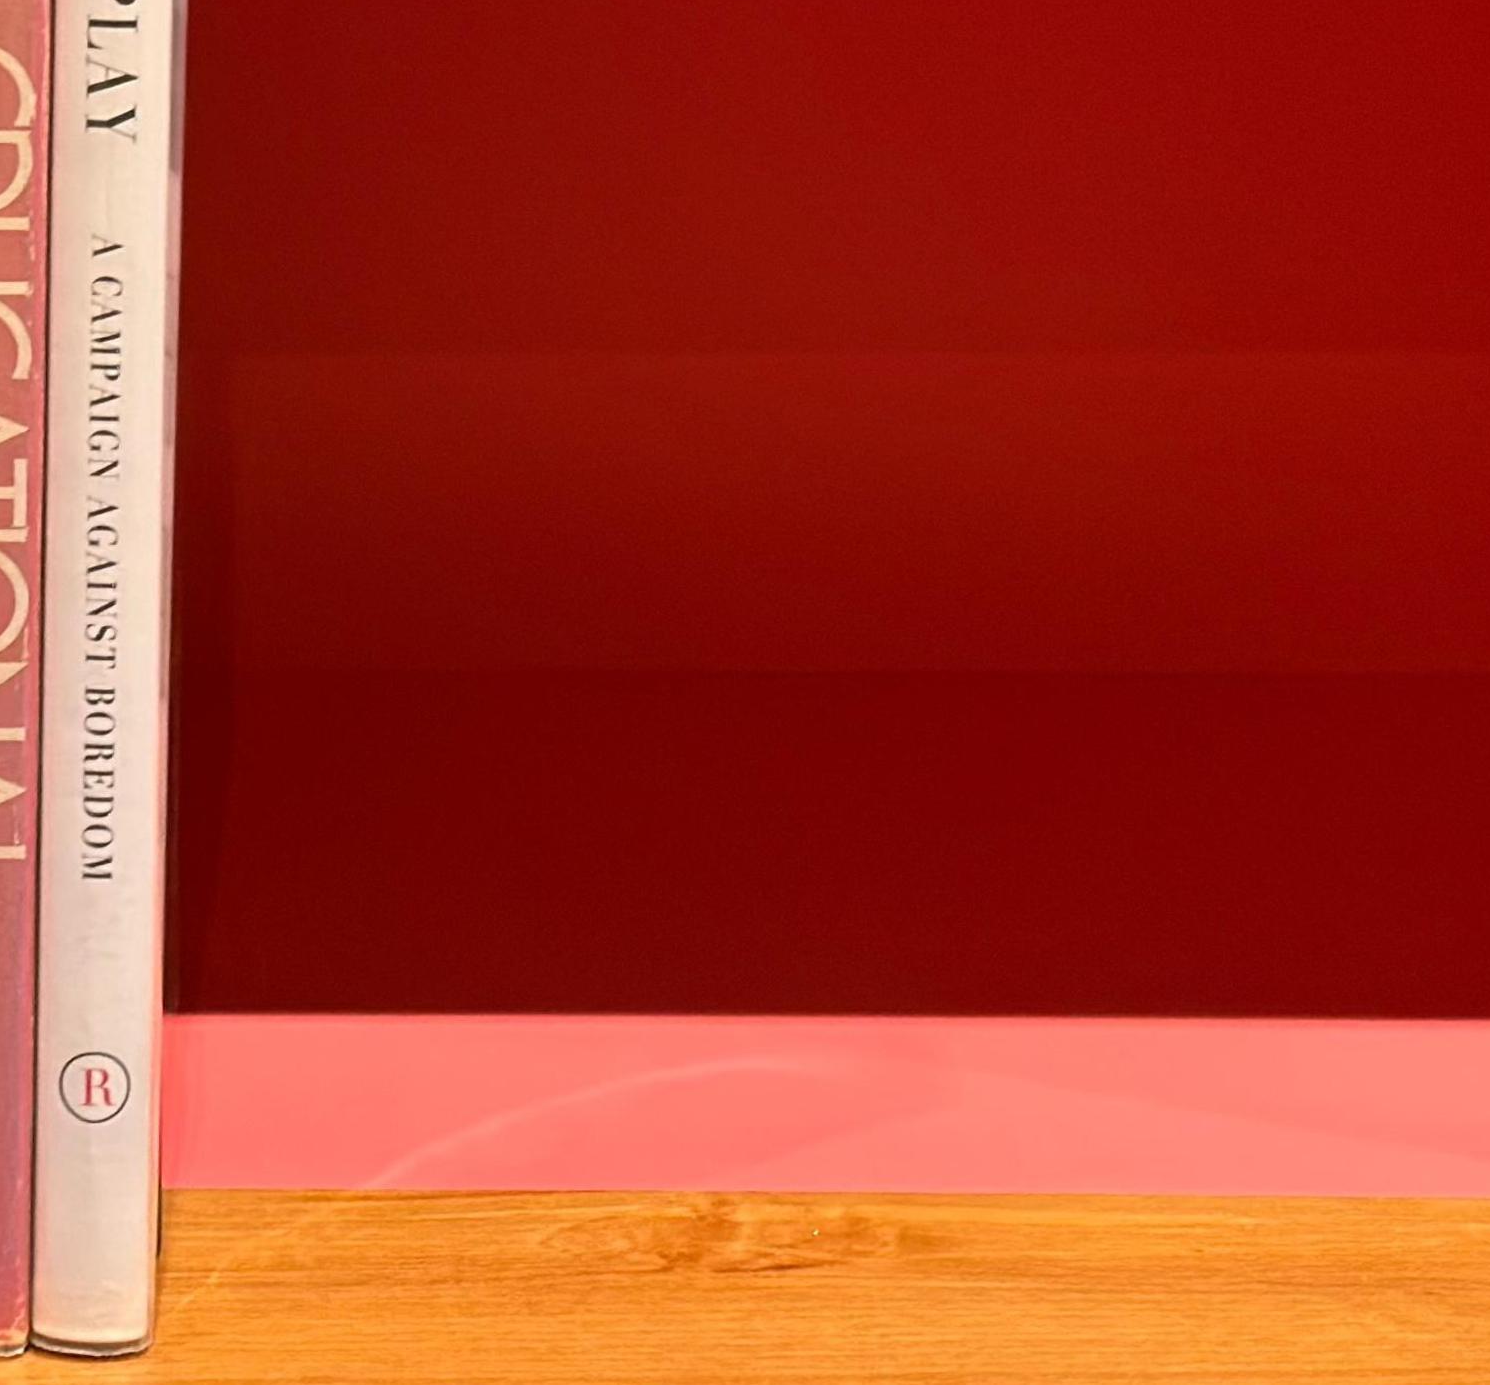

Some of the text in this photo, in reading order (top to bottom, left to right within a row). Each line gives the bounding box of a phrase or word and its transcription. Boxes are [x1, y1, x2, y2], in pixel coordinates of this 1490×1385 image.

[81, 234, 125, 881] A CAMPAIGN AGAINST BOREDOM
[81, 1068, 115, 1106] R
